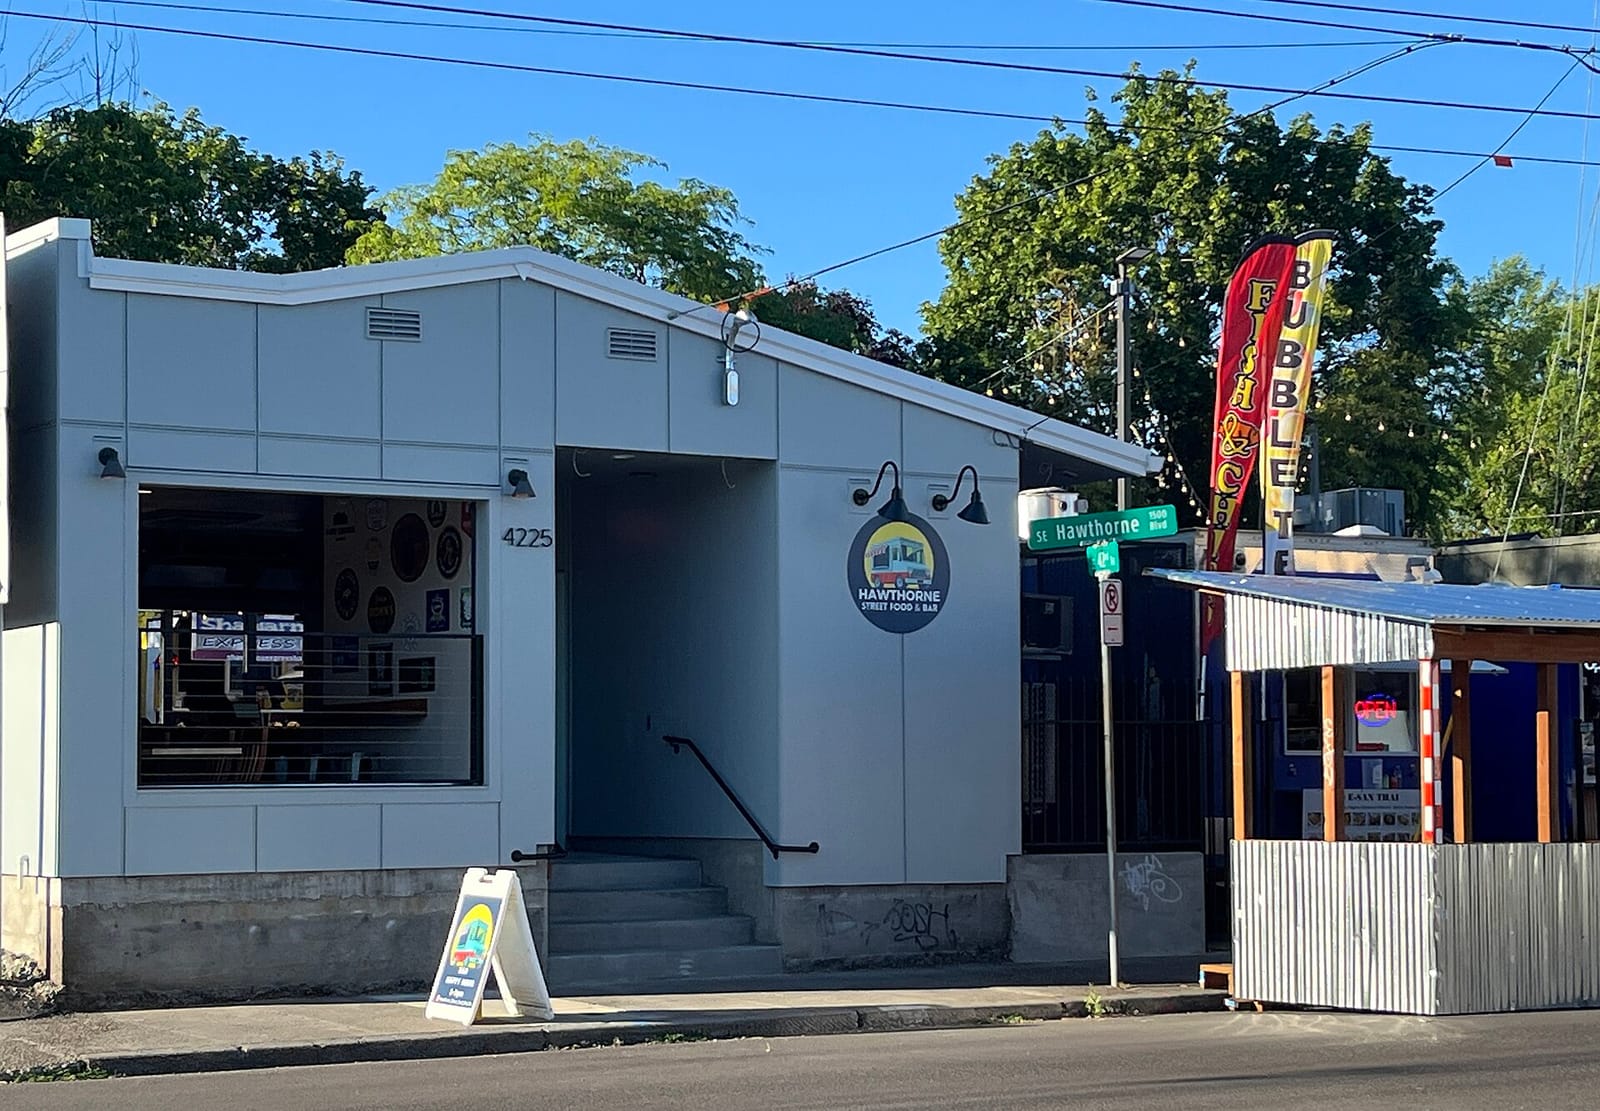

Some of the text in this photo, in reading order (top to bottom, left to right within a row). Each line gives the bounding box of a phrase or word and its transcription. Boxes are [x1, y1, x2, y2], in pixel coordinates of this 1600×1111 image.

[1231, 279, 1277, 410] FISH
[1269, 259, 1311, 575] BUBBLE TE
[1218, 411, 1251, 457] &
[502, 527, 553, 548] 4225
[1036, 530, 1048, 543] SE
[1056, 518, 1140, 540] Hawthorne
[858, 588, 941, 602] HAWTHORNE
[861, 602, 888, 611] STREET
[889, 602, 913, 612] FOOD
[922, 604, 938, 612] BAR
[202, 637, 296, 649] EXPESS
[1354, 700, 1397, 719] OPEN
[1375, 793, 1400, 801] THAI
